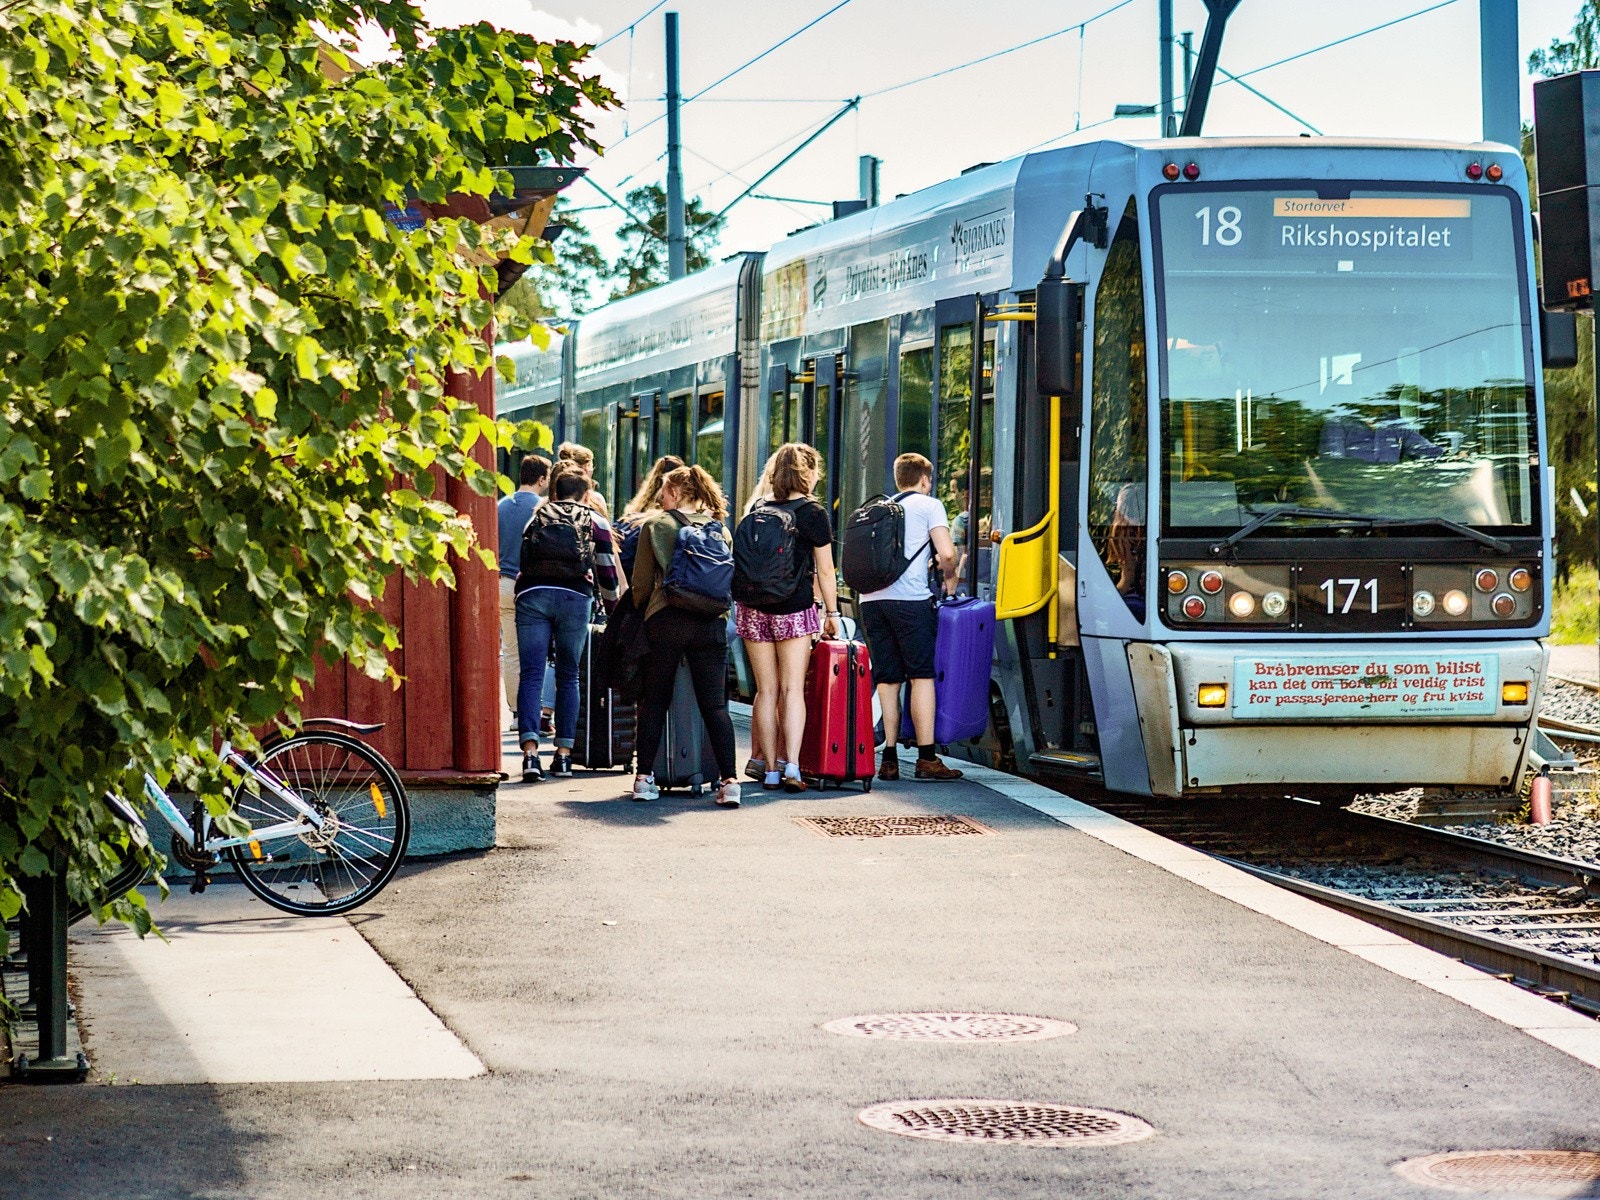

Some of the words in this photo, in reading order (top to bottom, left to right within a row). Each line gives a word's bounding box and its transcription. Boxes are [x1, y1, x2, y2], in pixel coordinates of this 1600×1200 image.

[1283, 200, 1346, 212] Stortorvet
[1194, 205, 1243, 247] 18
[1281, 223, 1452, 252] Rikshospitalet
[1319, 578, 1379, 614] 171
[1254, 662, 1360, 676] Bråbremser
[1365, 662, 1388, 676] du
[1393, 663, 1430, 675] som
[1435, 661, 1482, 675] bilist
[1249, 679, 1278, 690] kan
[1282, 678, 1307, 690] det
[1311, 680, 1335, 690] om
[1402, 676, 1449, 691] veldig
[1453, 676, 1486, 688] trist
[1249, 693, 1271, 704] for
[1275, 693, 1365, 707] passasjerene
[1368, 692, 1399, 703] herr
[1402, 693, 1419, 705] og
[1422, 691, 1445, 702] fru
[1449, 690, 1485, 702] kvist
